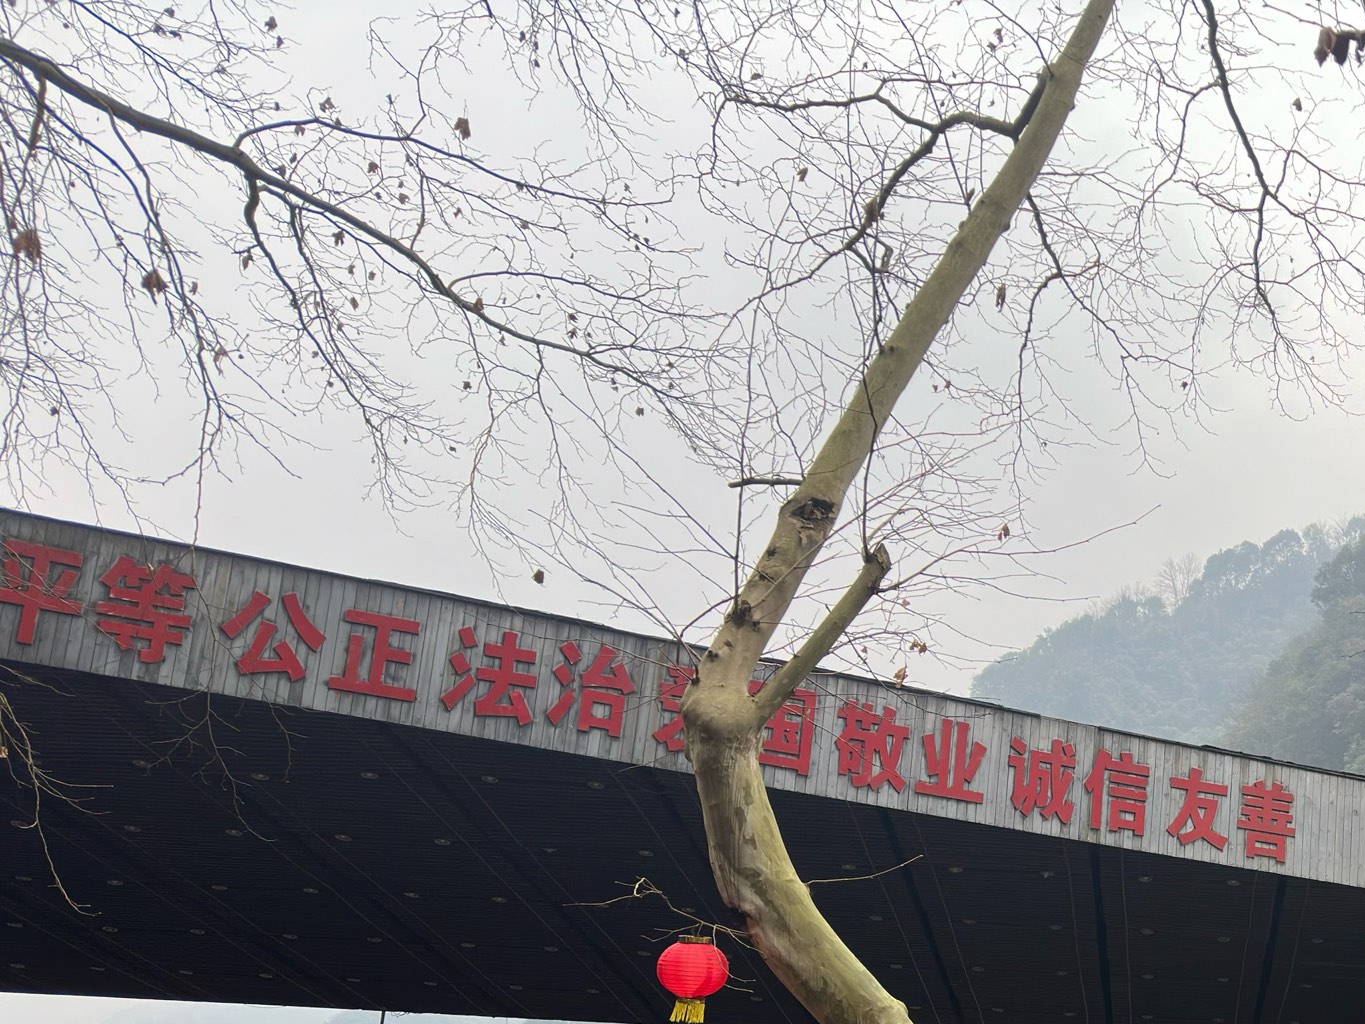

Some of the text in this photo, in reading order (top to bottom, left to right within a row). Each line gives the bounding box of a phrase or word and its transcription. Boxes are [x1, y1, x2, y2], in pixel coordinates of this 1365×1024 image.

[0, 538, 196, 663] 平等
[220, 591, 421, 702] 公正
[441, 625, 636, 738] 法治
[836, 700, 987, 804] 敬业
[1008, 737, 1151, 837] 诚信
[1168, 767, 1296, 863] 友善
